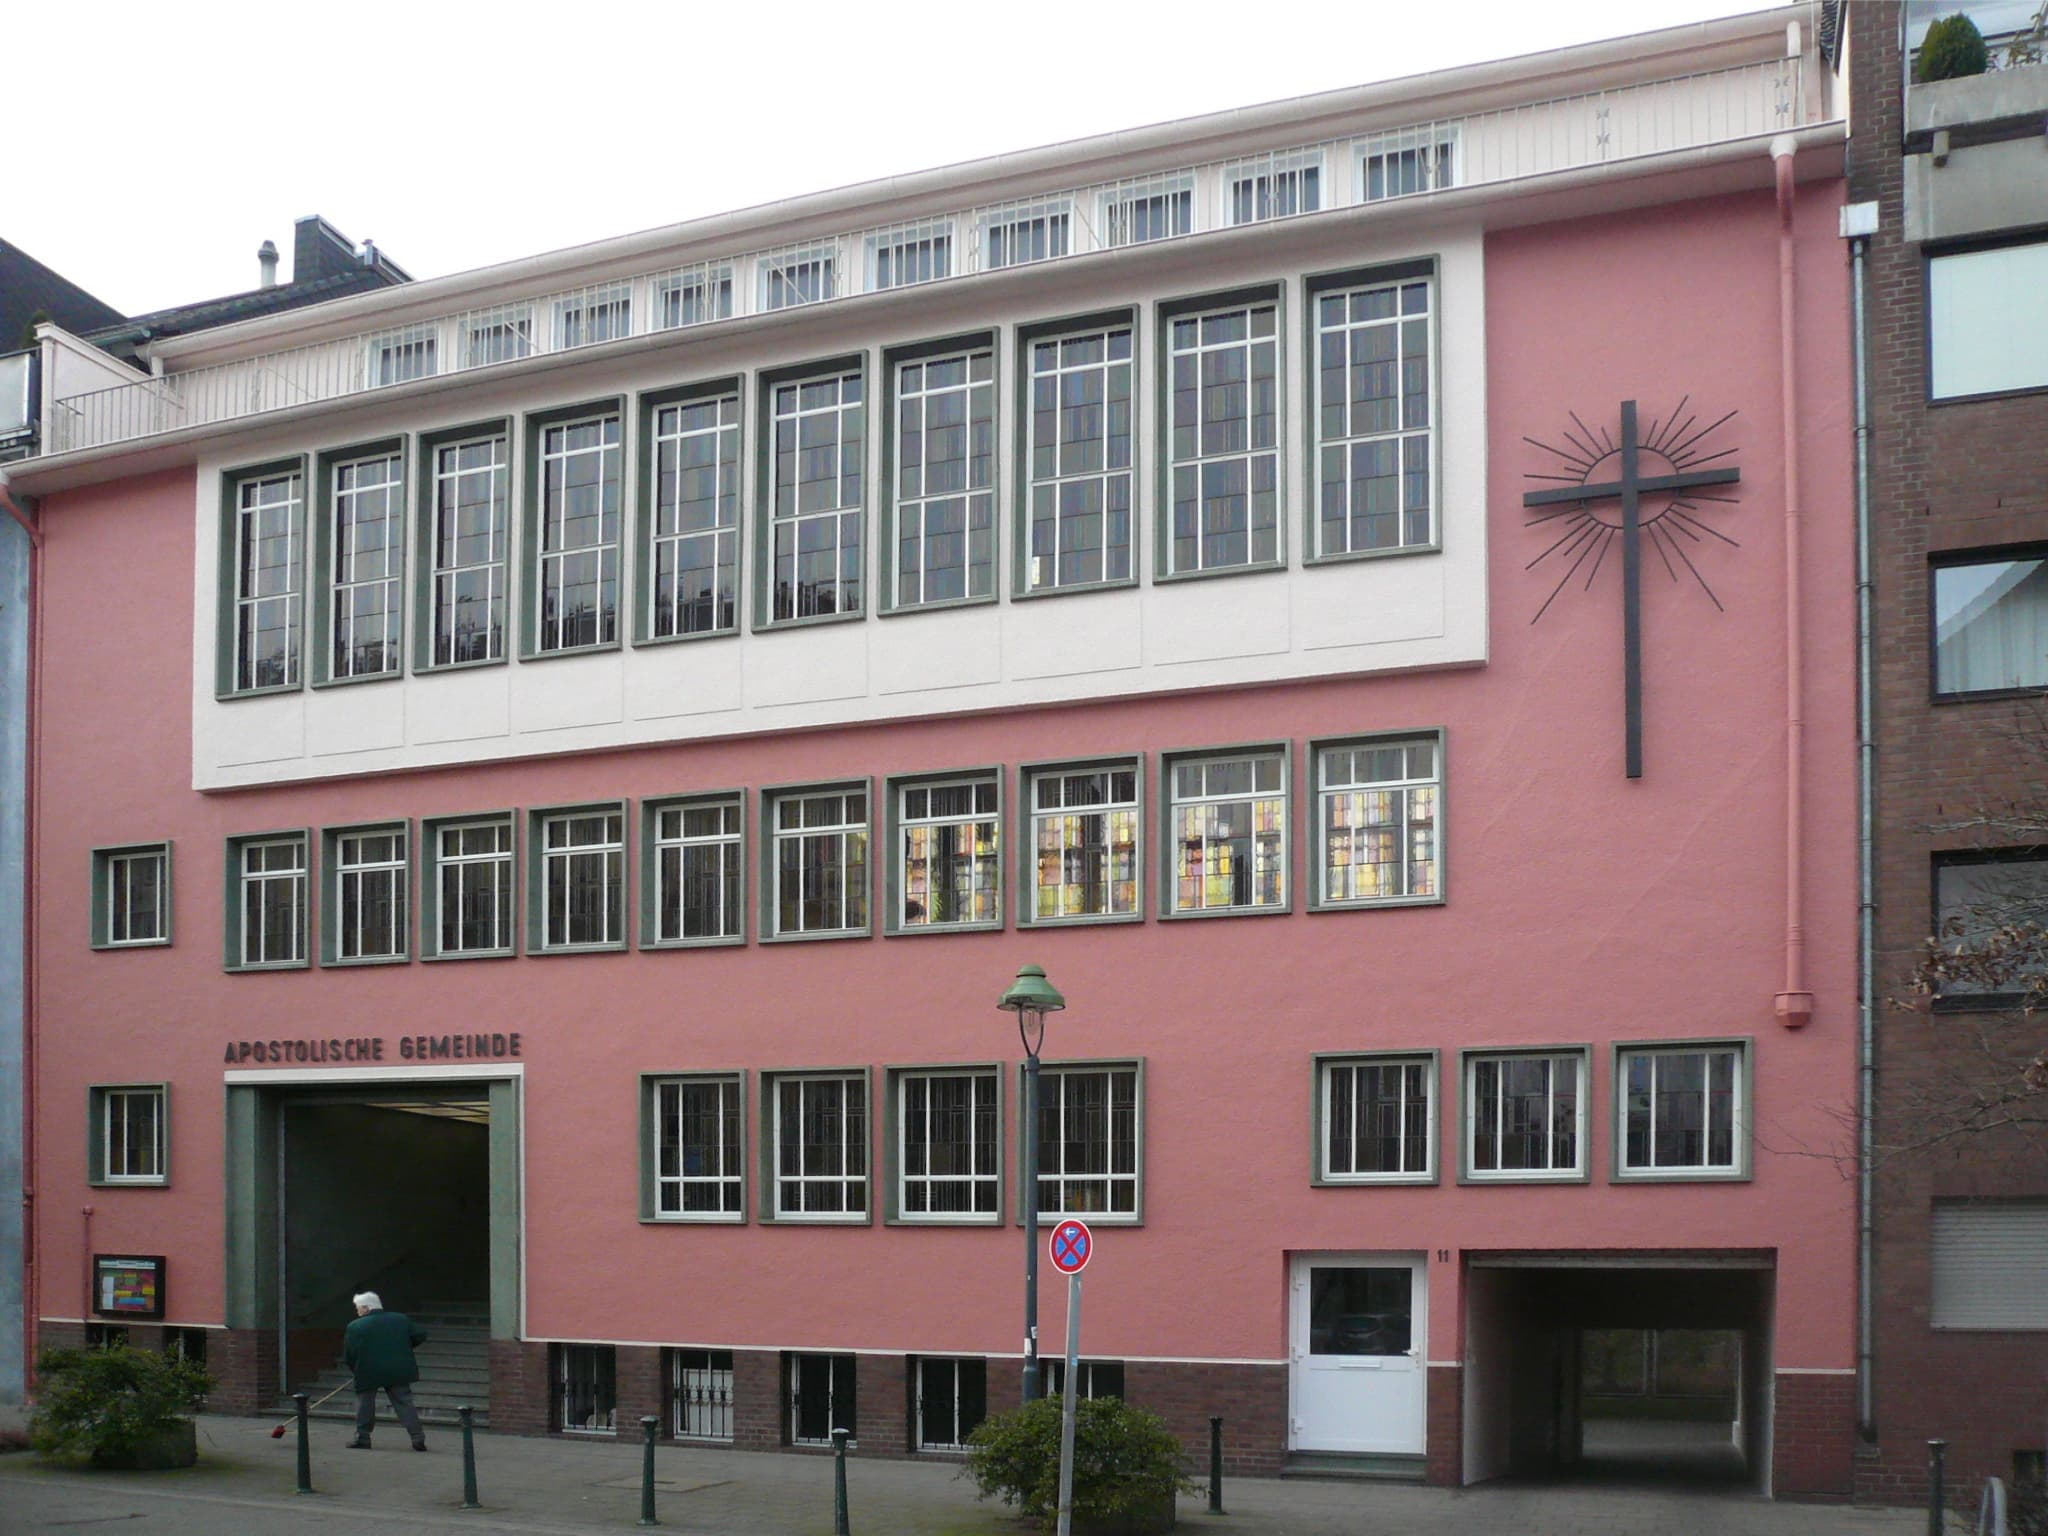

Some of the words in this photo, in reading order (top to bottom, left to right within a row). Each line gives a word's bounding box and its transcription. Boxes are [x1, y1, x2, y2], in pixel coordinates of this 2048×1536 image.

[224, 1037, 384, 1063] APOSTOLISCHE
[400, 1032, 521, 1060] GEMEINDE
[1437, 1249, 1449, 1263] 11
